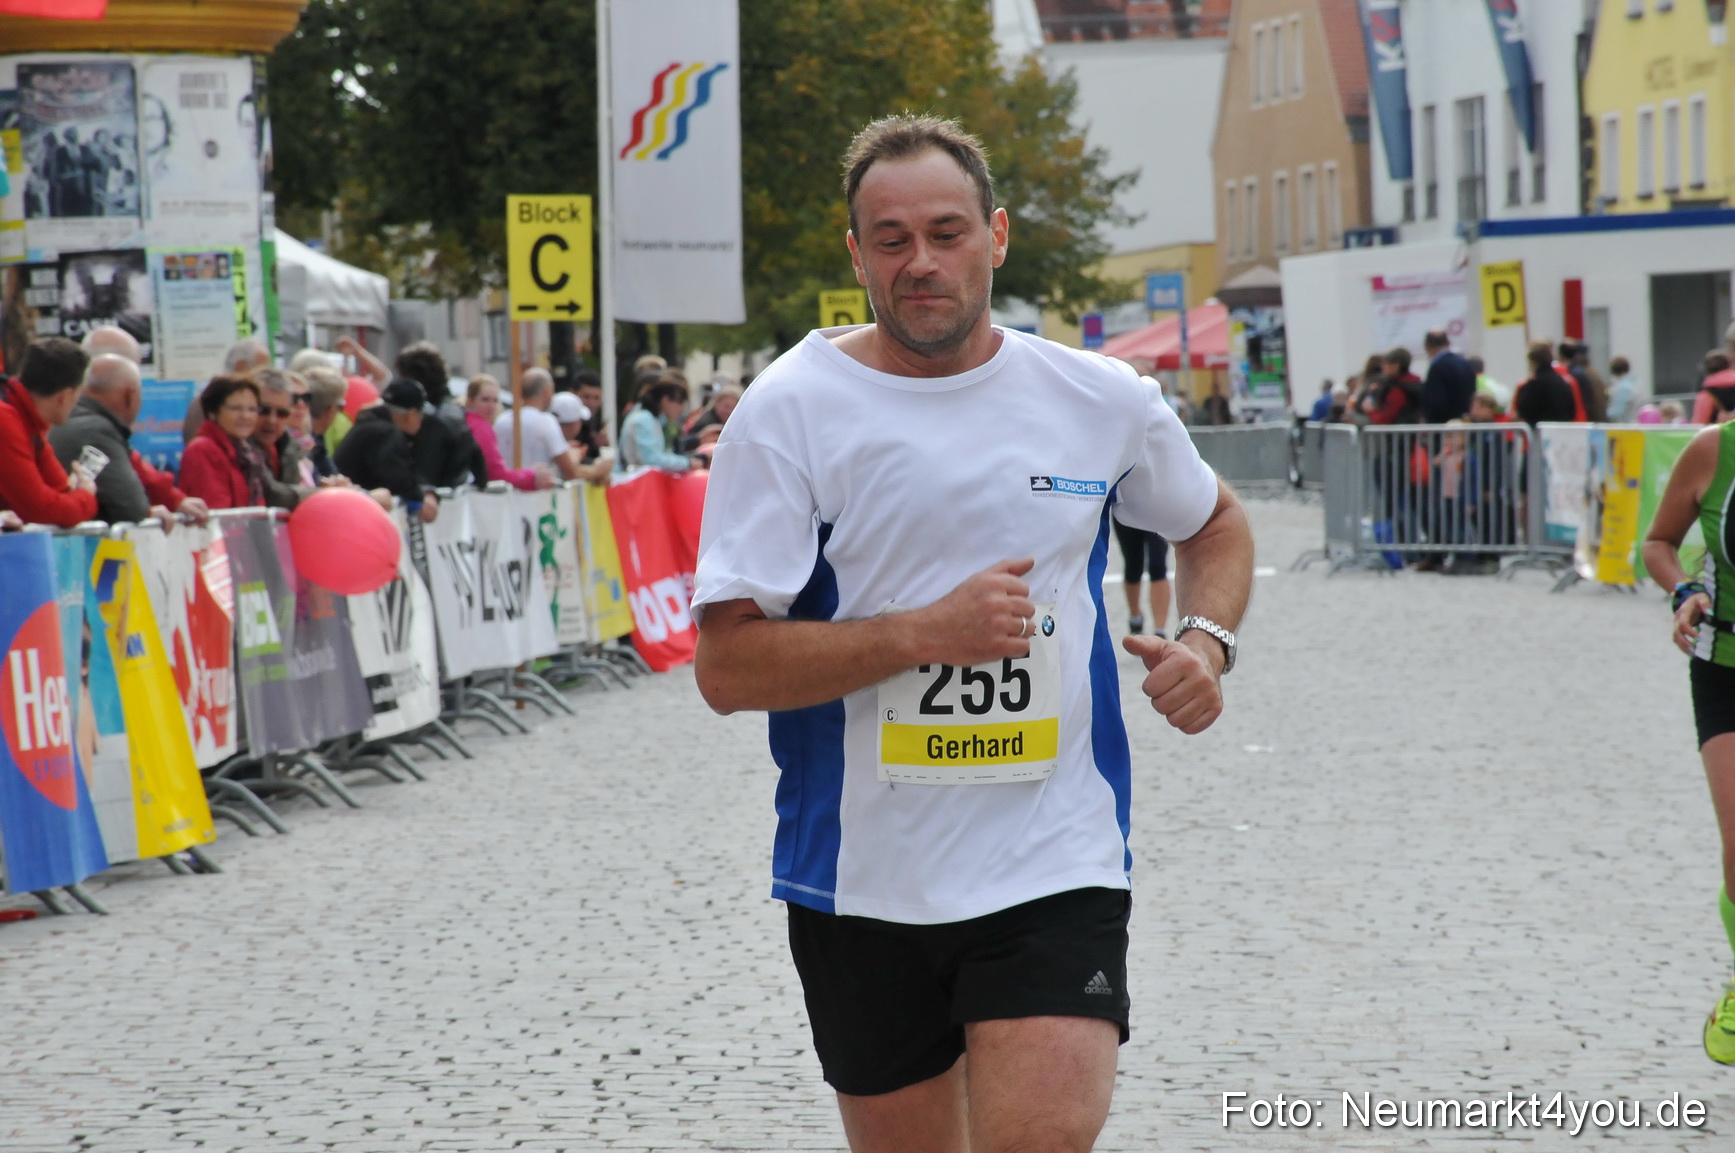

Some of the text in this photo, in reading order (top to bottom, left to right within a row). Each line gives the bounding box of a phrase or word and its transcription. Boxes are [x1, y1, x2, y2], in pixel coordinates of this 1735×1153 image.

[519, 202, 582, 223] Block
[531, 234, 569, 292] C
[1492, 281, 1516, 313] D
[919, 650, 1031, 715] 255
[887, 709, 894, 722] C
[926, 731, 1024, 759] Gerhard
[1084, 985, 1113, 995] adidas
